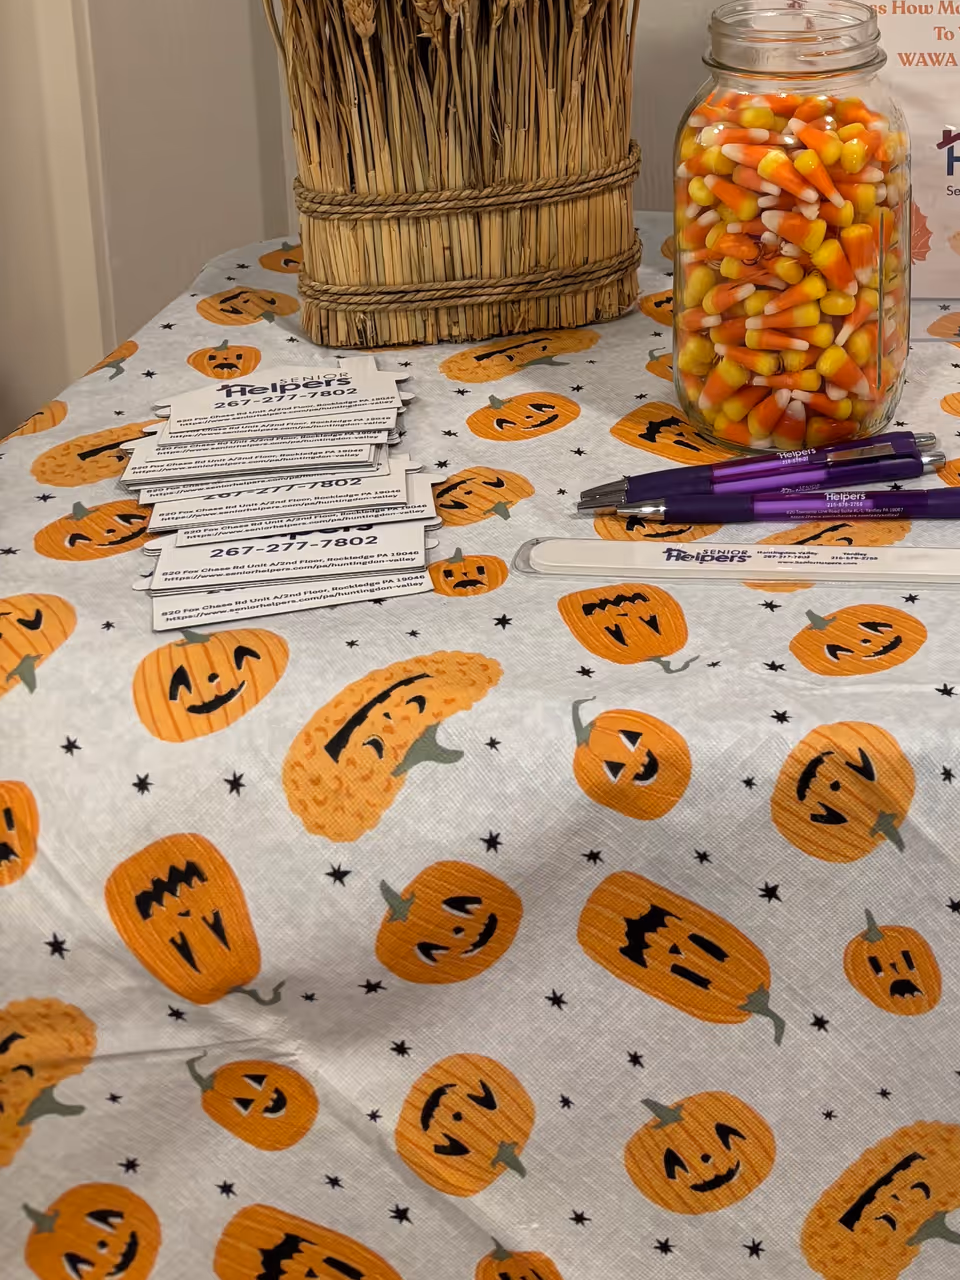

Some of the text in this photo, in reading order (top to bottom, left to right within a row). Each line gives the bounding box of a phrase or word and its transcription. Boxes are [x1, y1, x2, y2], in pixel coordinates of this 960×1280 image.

[891, 0, 933, 15] How
[933, 26, 954, 41] To
[897, 52, 957, 67] WAWA
[280, 372, 349, 384] SENIOR
[225, 377, 352, 398] Helpers
[214, 388, 357, 409] 267-277-7802
[779, 448, 817, 459] Helpers
[826, 493, 866, 504] Helpers
[210, 536, 378, 558] 267-277-7802
[327, 554, 374, 562] Rockledge
[666, 552, 748, 564] Helpers
[332, 581, 380, 591] Rockledge
